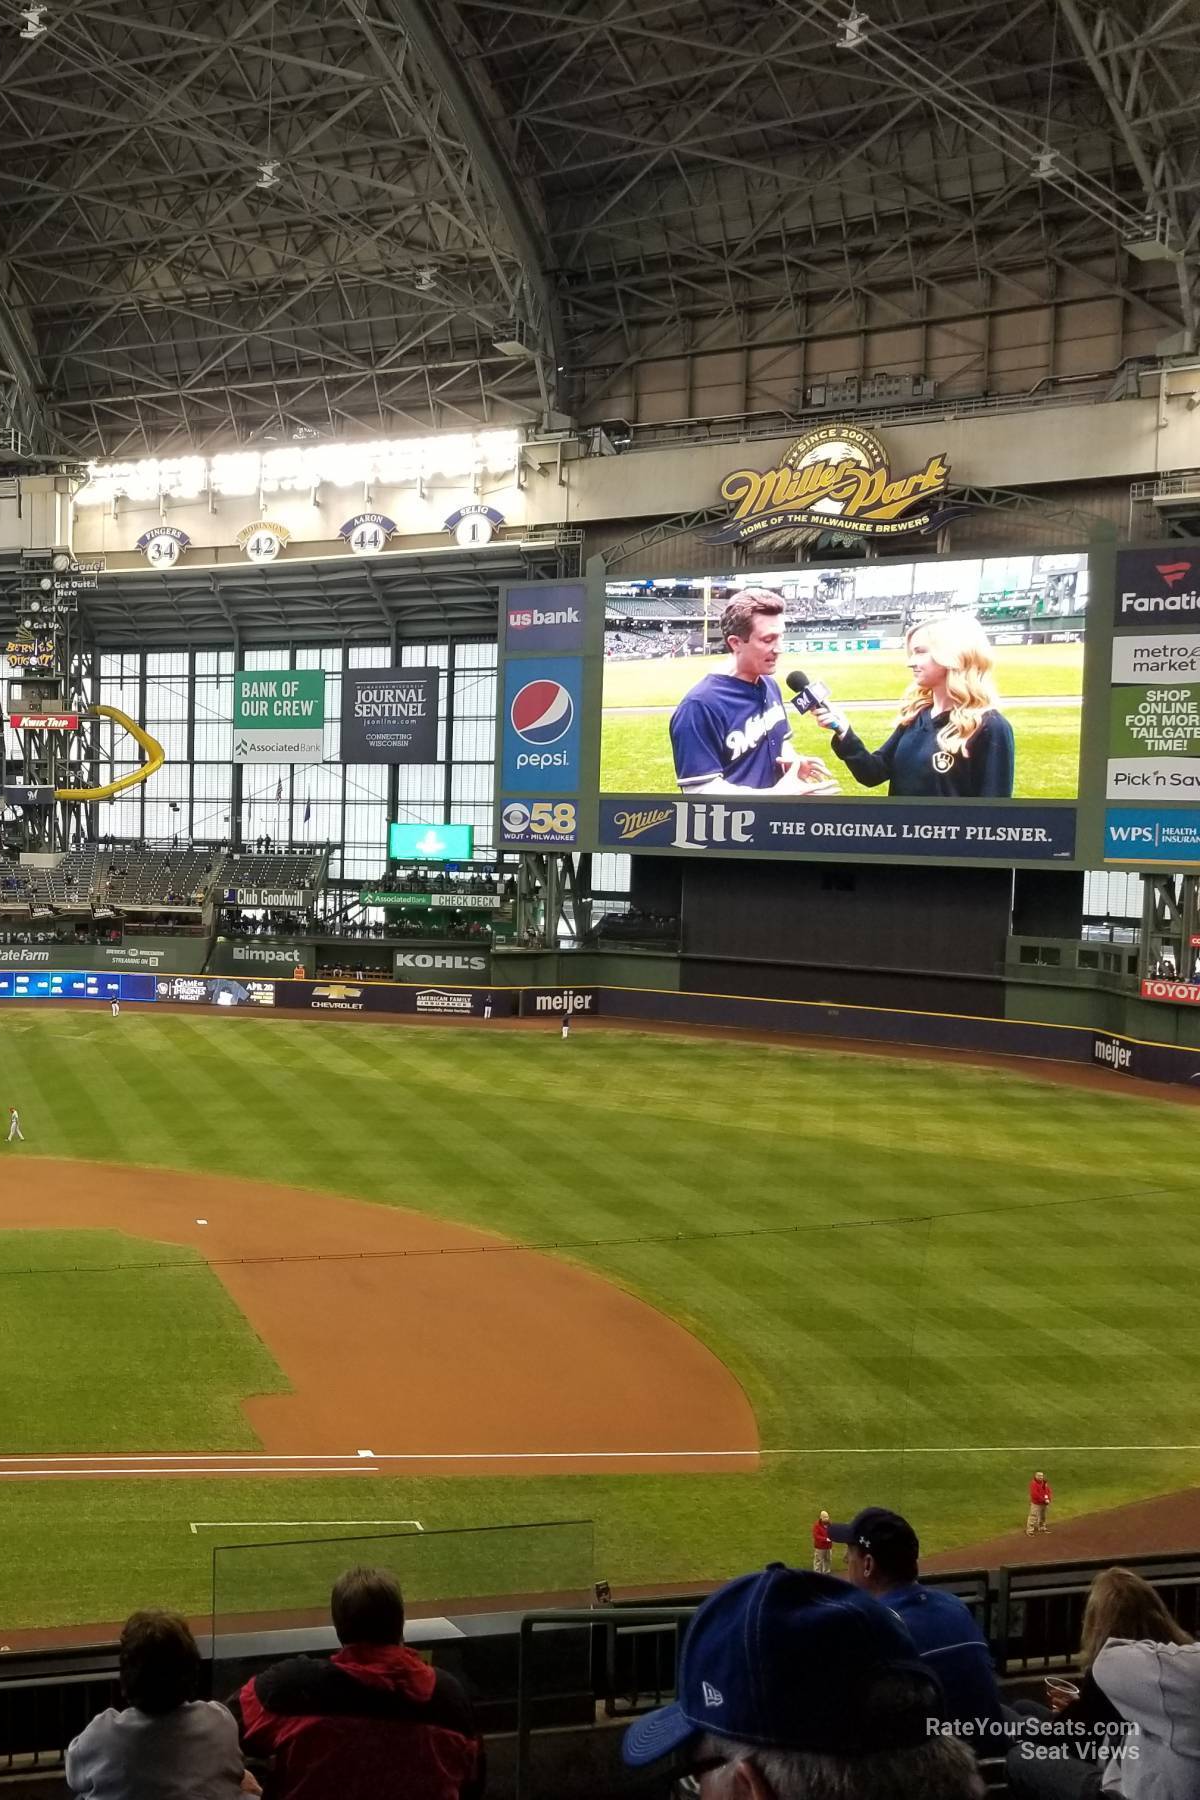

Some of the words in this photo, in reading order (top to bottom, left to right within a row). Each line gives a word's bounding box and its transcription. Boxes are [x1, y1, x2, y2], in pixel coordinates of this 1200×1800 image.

[798, 429, 837, 452] SINCE
[840, 428, 869, 446] 2001
[720, 457, 858, 521] Miller
[829, 456, 947, 518] Park
[459, 505, 489, 517] SELIG
[353, 514, 384, 526] AARON
[739, 519, 768, 538] HOME
[769, 515, 785, 526] OF
[787, 514, 808, 523] THE
[811, 515, 873, 533] MILWAUKEE
[875, 515, 930, 533] BREWERS
[145, 527, 182, 541] FINGERS
[354, 529, 381, 549] 44
[469, 522, 479, 543] 1
[151, 542, 175, 562] 34
[250, 537, 275, 555] 42
[70, 561, 105, 571] Gone!
[54, 581, 69, 589] Get
[57, 605, 69, 613] Up
[1051, 632, 1080, 643] meijer
[1133, 645, 1188, 658] metro
[1133, 659, 1197, 672] market
[241, 681, 278, 698] BANK
[281, 681, 300, 698] OF
[354, 688, 427, 705] JOURNAL
[1145, 689, 1191, 702] SHOP
[241, 700, 269, 717] OUR
[354, 703, 426, 718] SENTINEL
[1138, 702, 1198, 714] ONLINE
[20, 716, 47, 727] KWIK
[46, 717, 69, 727] TRIP
[363, 719, 417, 727] jsonline.com
[1125, 714, 1157, 727] FOR
[1161, 714, 1200, 727] MOR
[365, 733, 412, 741] CONNECTING
[1144, 739, 1188, 751] TIME!
[517, 750, 567, 770] pepsi
[1114, 772, 1151, 786] Pick
[1170, 772, 1200, 787] Sav
[529, 803, 577, 834] 58
[613, 808, 675, 839] Miller
[670, 801, 756, 849] Lite
[769, 821, 806, 836] THE
[810, 822, 897, 838] ORIGINAL
[902, 824, 961, 840] LIGHT
[965, 826, 1052, 842] PILSNER.
[1110, 826, 1153, 842] WPS
[1162, 827, 1197, 836] HEALTH
[1162, 834, 1200, 843] INSURAN
[237, 890, 258, 905] Club
[260, 889, 303, 907] Goodwill
[438, 895, 468, 906] CHECK
[471, 895, 495, 907] DECK
[245, 946, 300, 963] impact
[396, 953, 486, 970] KOHL'S
[174, 978, 198, 988] GAME
[246, 981, 263, 991] APR
[263, 983, 274, 991] 20
[172, 985, 207, 996] THRONES
[311, 1001, 363, 1010] CHEVROLET
[536, 990, 593, 1014] meijer
[1094, 1039, 1132, 1069] meijer
